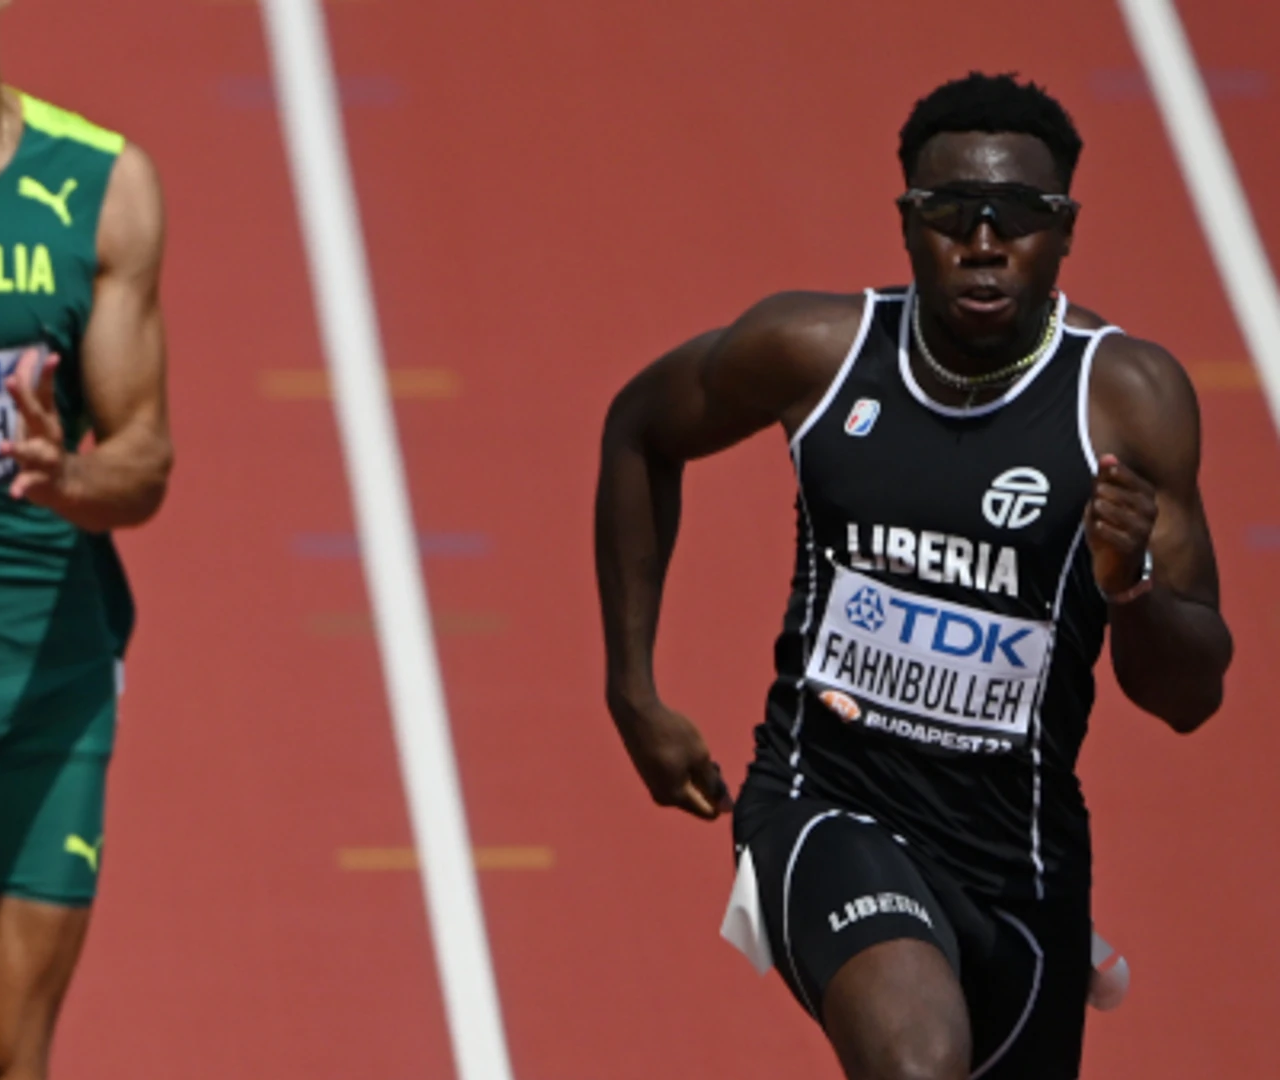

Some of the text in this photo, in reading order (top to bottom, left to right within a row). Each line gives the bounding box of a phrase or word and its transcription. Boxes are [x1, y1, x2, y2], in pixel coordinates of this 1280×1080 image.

[846, 522, 1019, 597] LIBERIA
[889, 597, 1034, 669] TDK
[819, 631, 1025, 724] FAHNBULLEH
[864, 709, 983, 753] BUDAPEST
